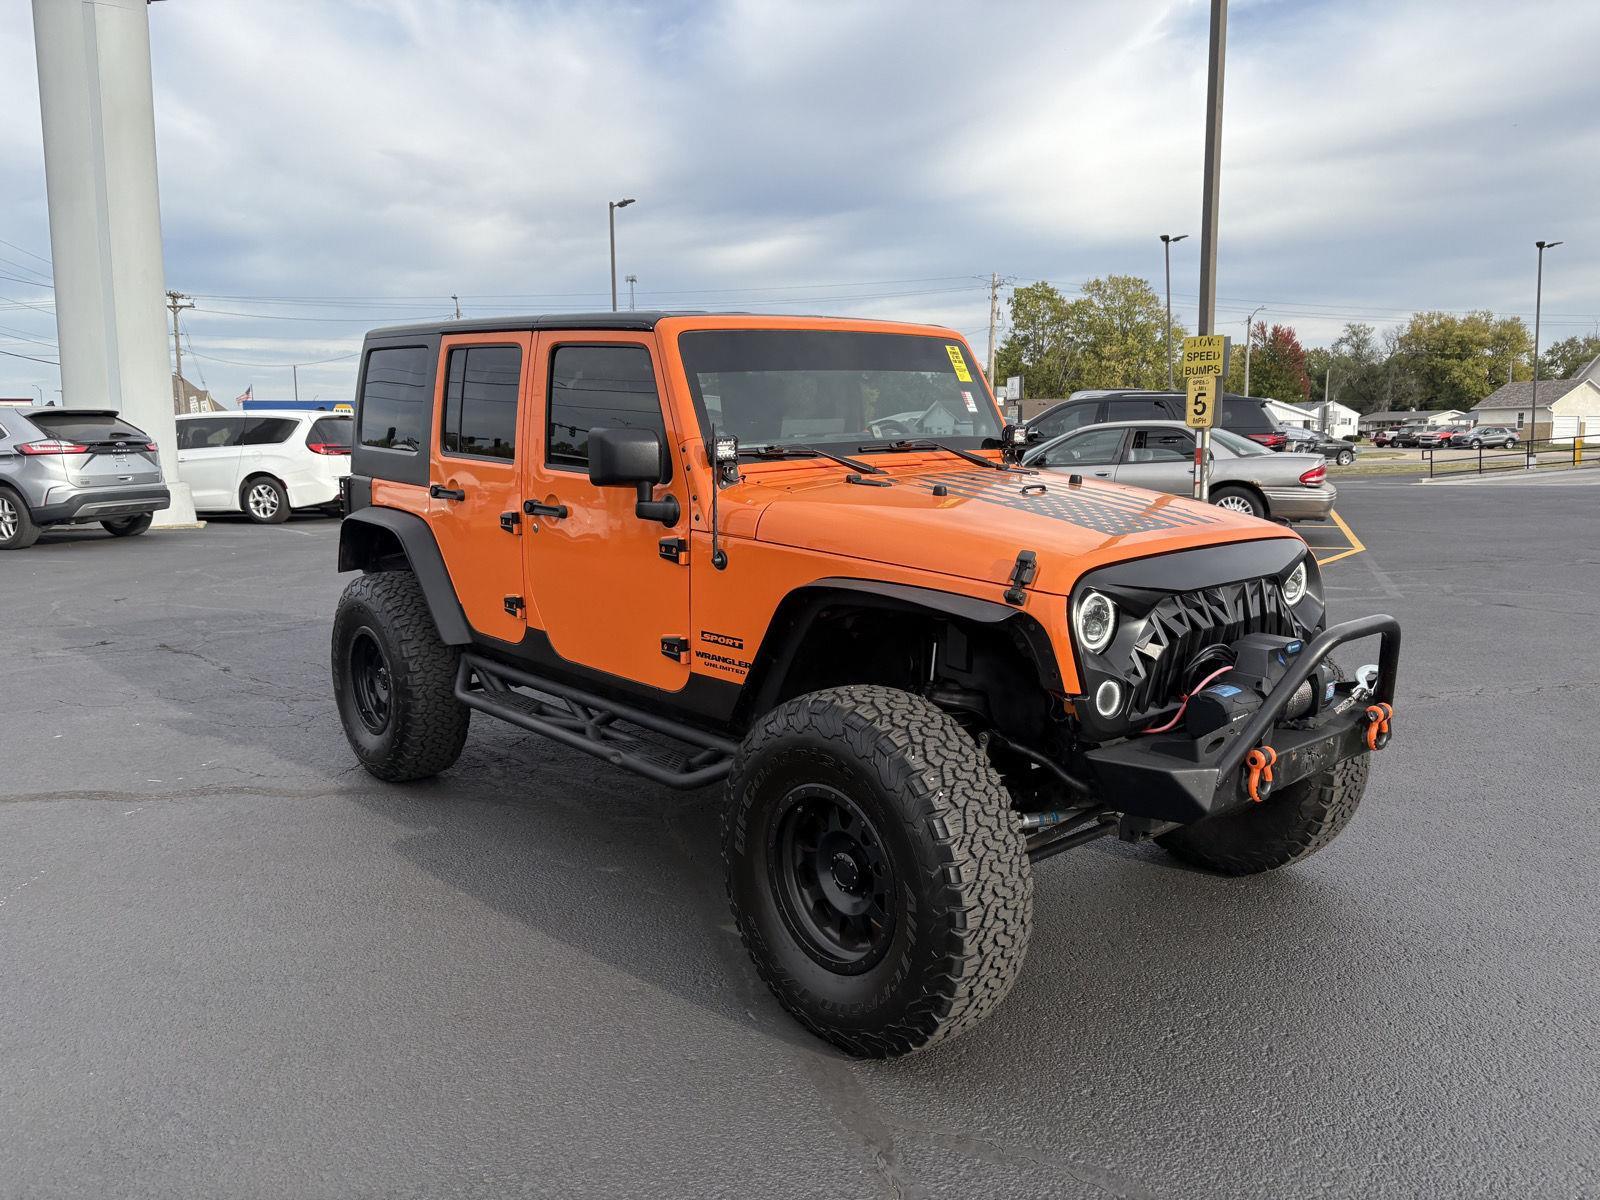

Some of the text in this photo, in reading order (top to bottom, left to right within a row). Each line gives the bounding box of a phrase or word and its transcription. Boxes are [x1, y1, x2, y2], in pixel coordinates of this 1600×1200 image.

[1186, 351, 1221, 361] SPEED
[1185, 364, 1221, 375] BUMPS
[1193, 392, 1207, 416] 5
[702, 632, 742, 647] SPORT
[695, 650, 752, 669] WRANGLER
[704, 661, 746, 675] UNLIMITED
